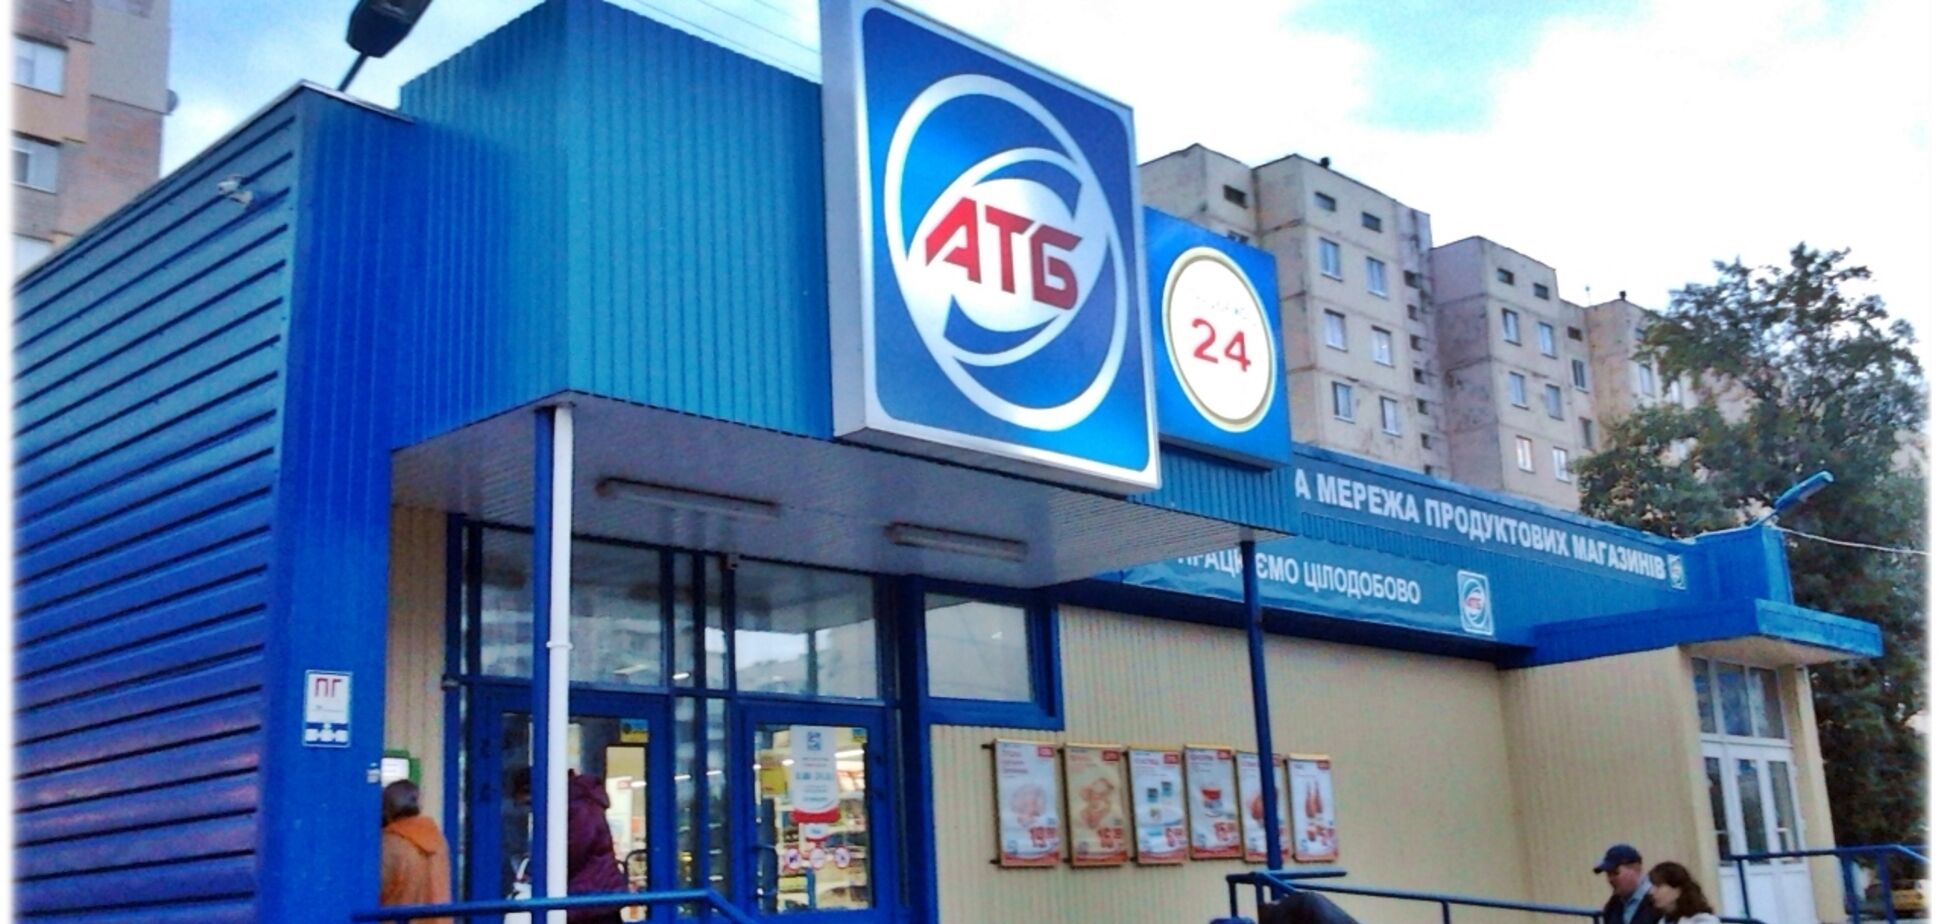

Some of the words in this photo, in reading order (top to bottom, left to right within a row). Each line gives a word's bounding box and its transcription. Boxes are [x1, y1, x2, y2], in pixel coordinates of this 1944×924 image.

[925, 197, 1083, 311] АТБ
[1192, 318, 1251, 372] 24
[1316, 473, 1420, 523] МЕРЕЖА
[1425, 498, 1570, 557] ПРОДУКТОВИХ
[1572, 534, 1667, 580] МАГАЗИНІВ
[1303, 561, 1422, 605] ЦІЛОДОБОВО
[315, 678, 342, 697] ПГ
